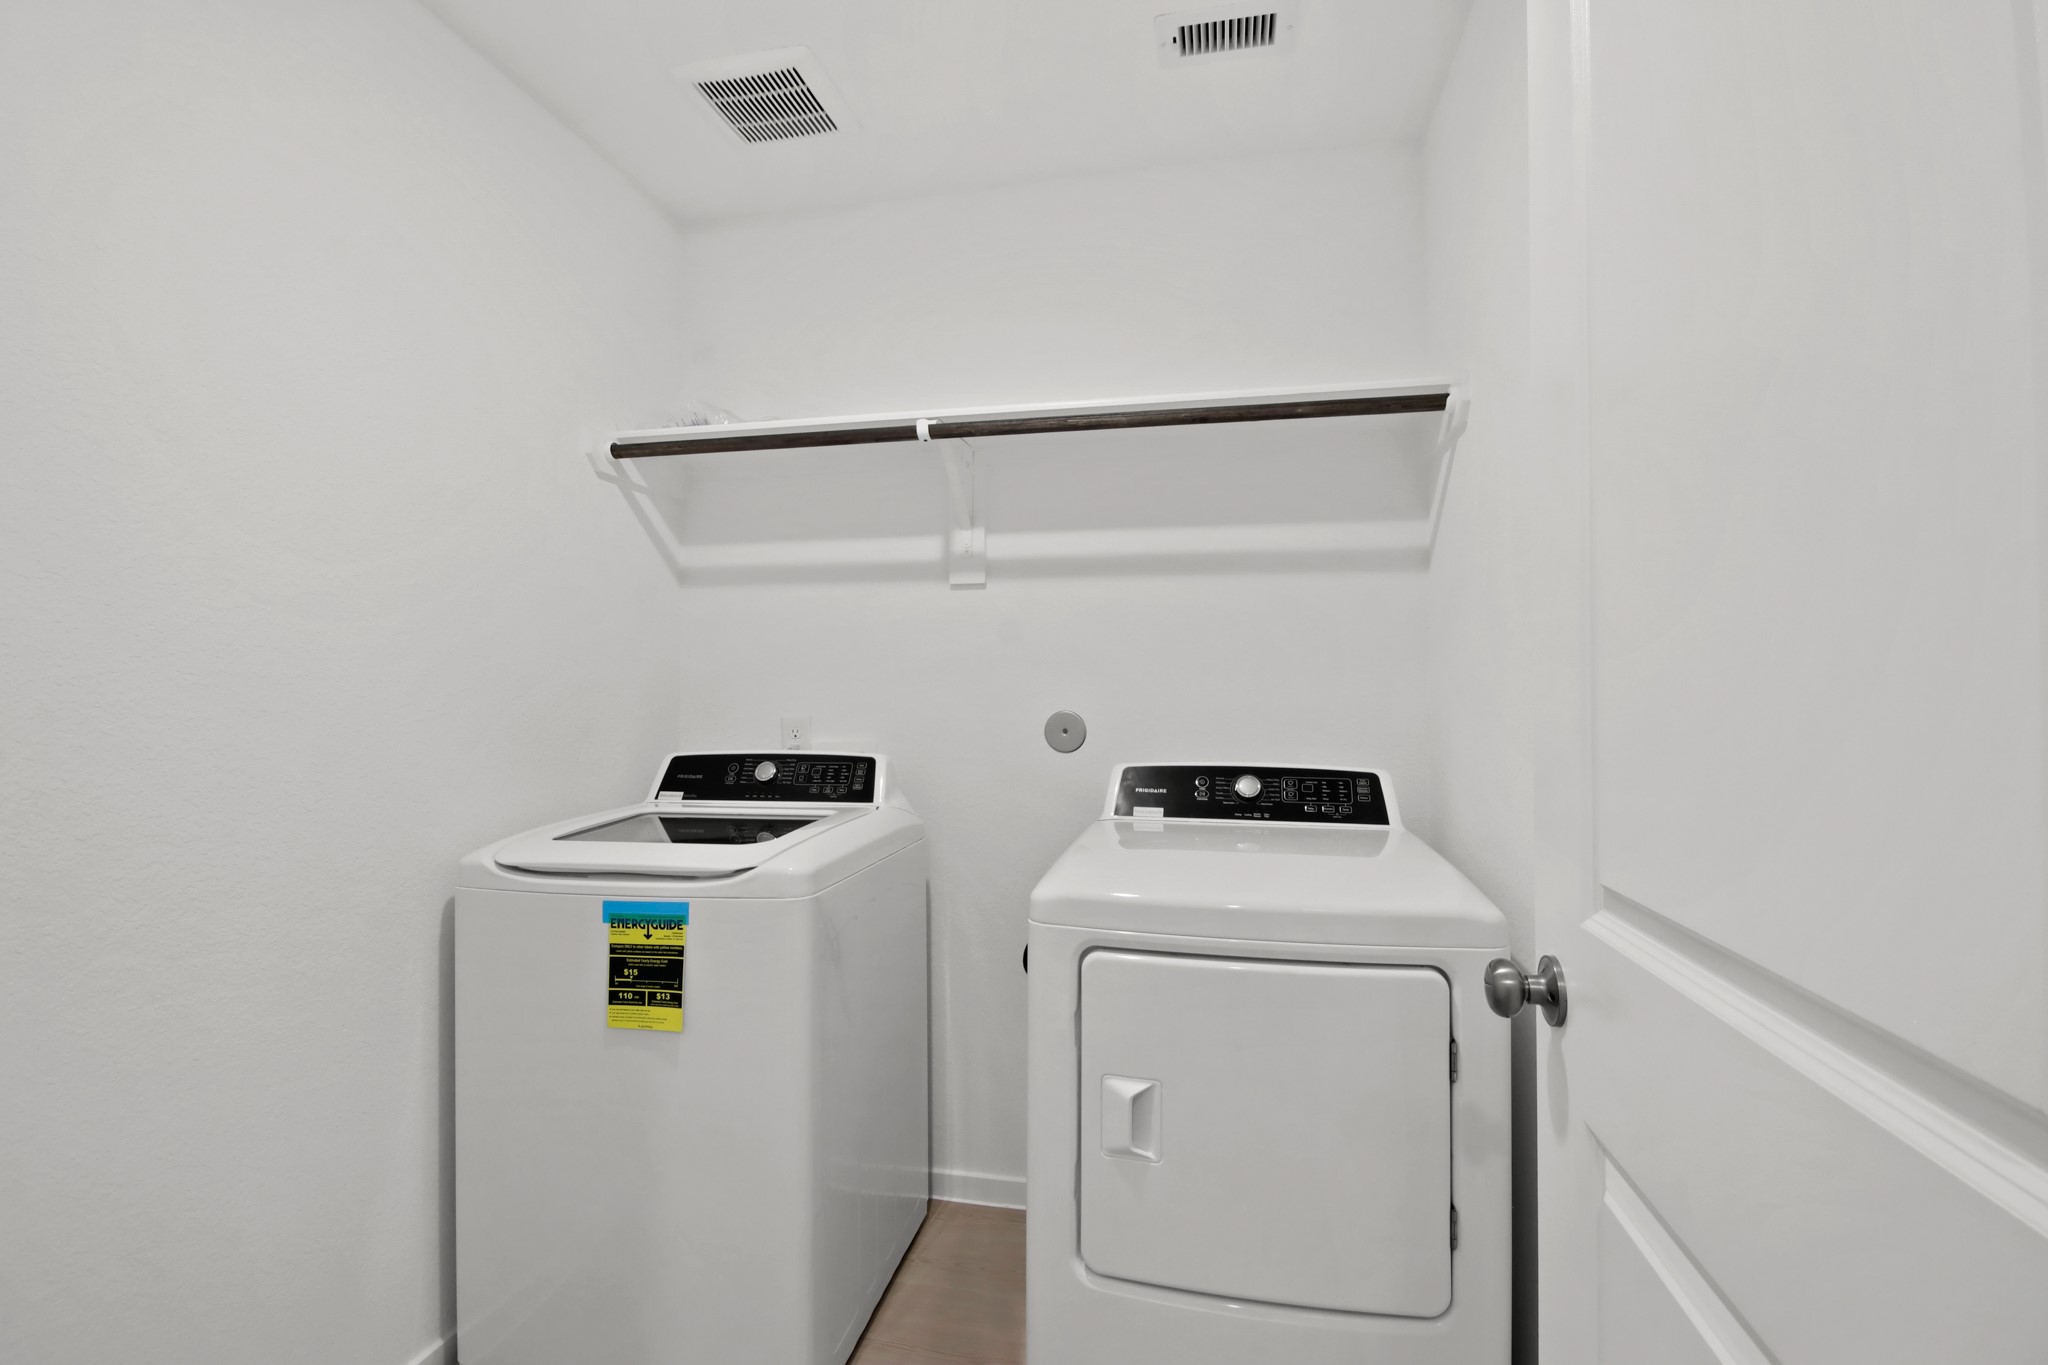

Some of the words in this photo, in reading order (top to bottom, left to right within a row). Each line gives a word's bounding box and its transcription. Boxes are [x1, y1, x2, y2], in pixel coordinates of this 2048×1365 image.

[611, 919, 684, 930] ENERGYGUIDE
[623, 968, 639, 976] $15
[618, 992, 633, 1000] 110
